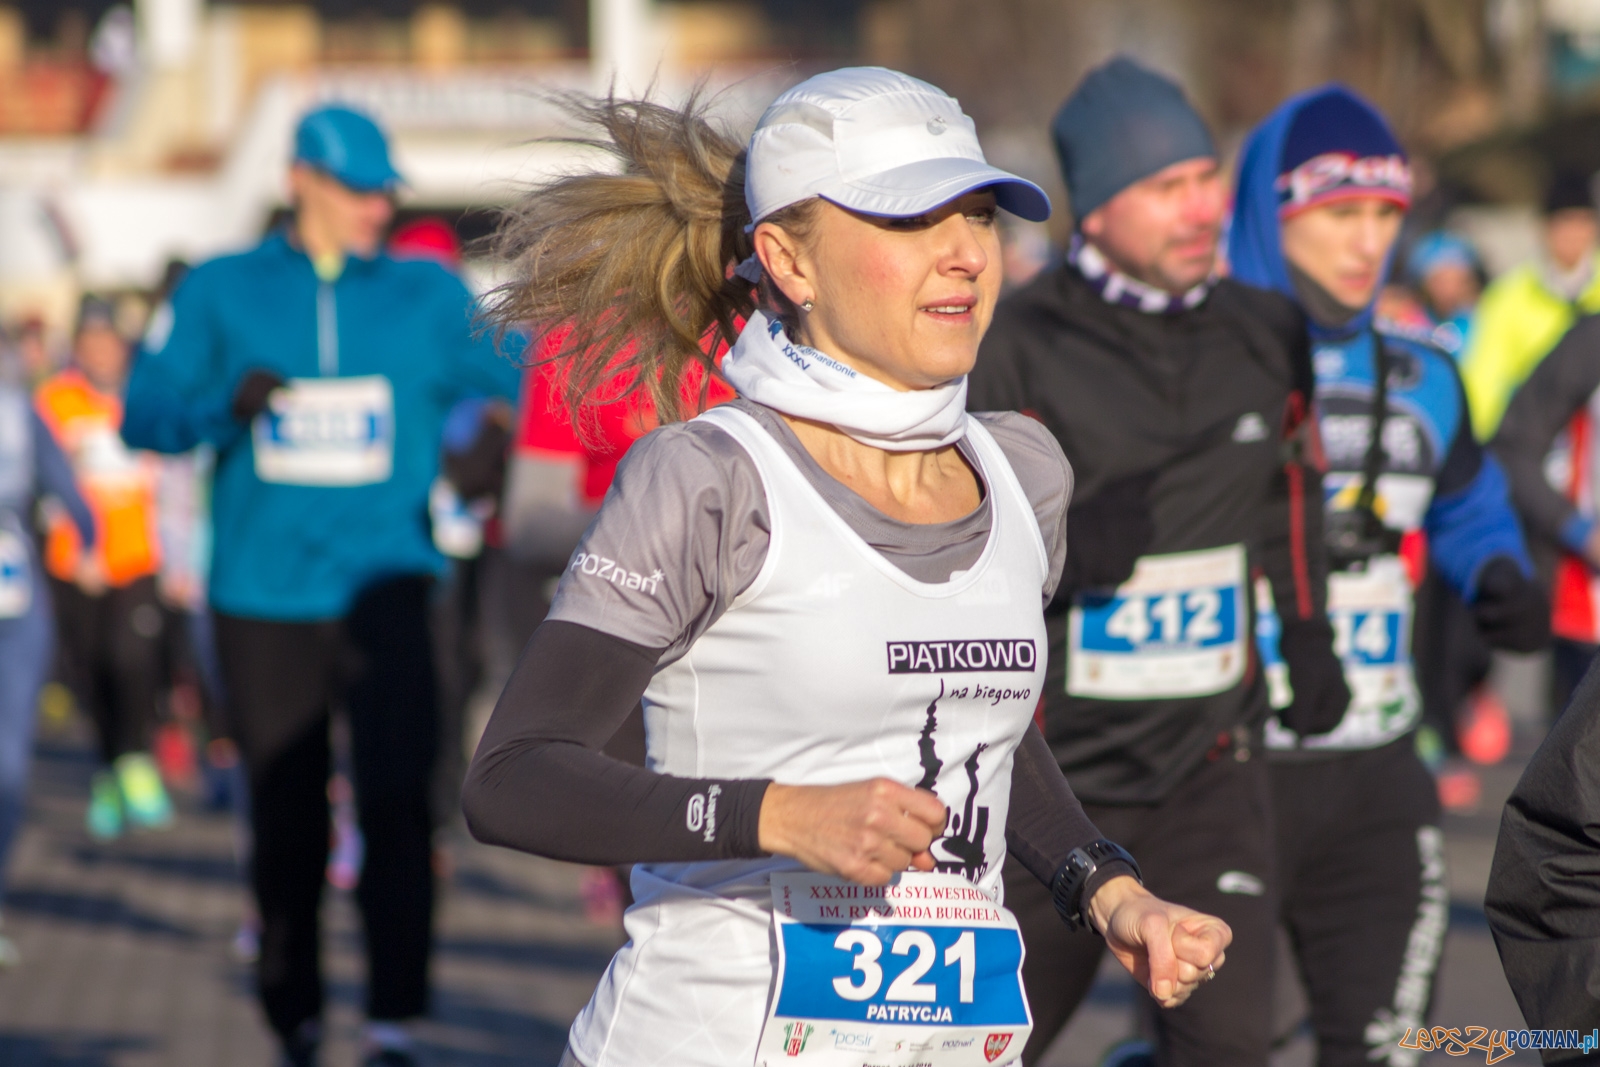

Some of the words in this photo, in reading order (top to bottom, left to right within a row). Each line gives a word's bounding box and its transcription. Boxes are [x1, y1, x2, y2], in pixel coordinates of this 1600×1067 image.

[782, 343, 811, 371] XXXV
[1106, 588, 1222, 642] 412
[1332, 609, 1391, 656] 14
[889, 641, 1035, 673] PIĄTKOWO
[950, 687, 968, 699] na
[973, 683, 1031, 706] biegowo
[810, 885, 858, 899] XXXII
[863, 885, 901, 899] BIEG
[820, 905, 845, 919] IM.
[849, 905, 932, 919] RYSZARDA
[936, 906, 1001, 922] BURGIELA
[832, 929, 976, 1003] 321
[866, 1004, 953, 1022] PATRYCJA
